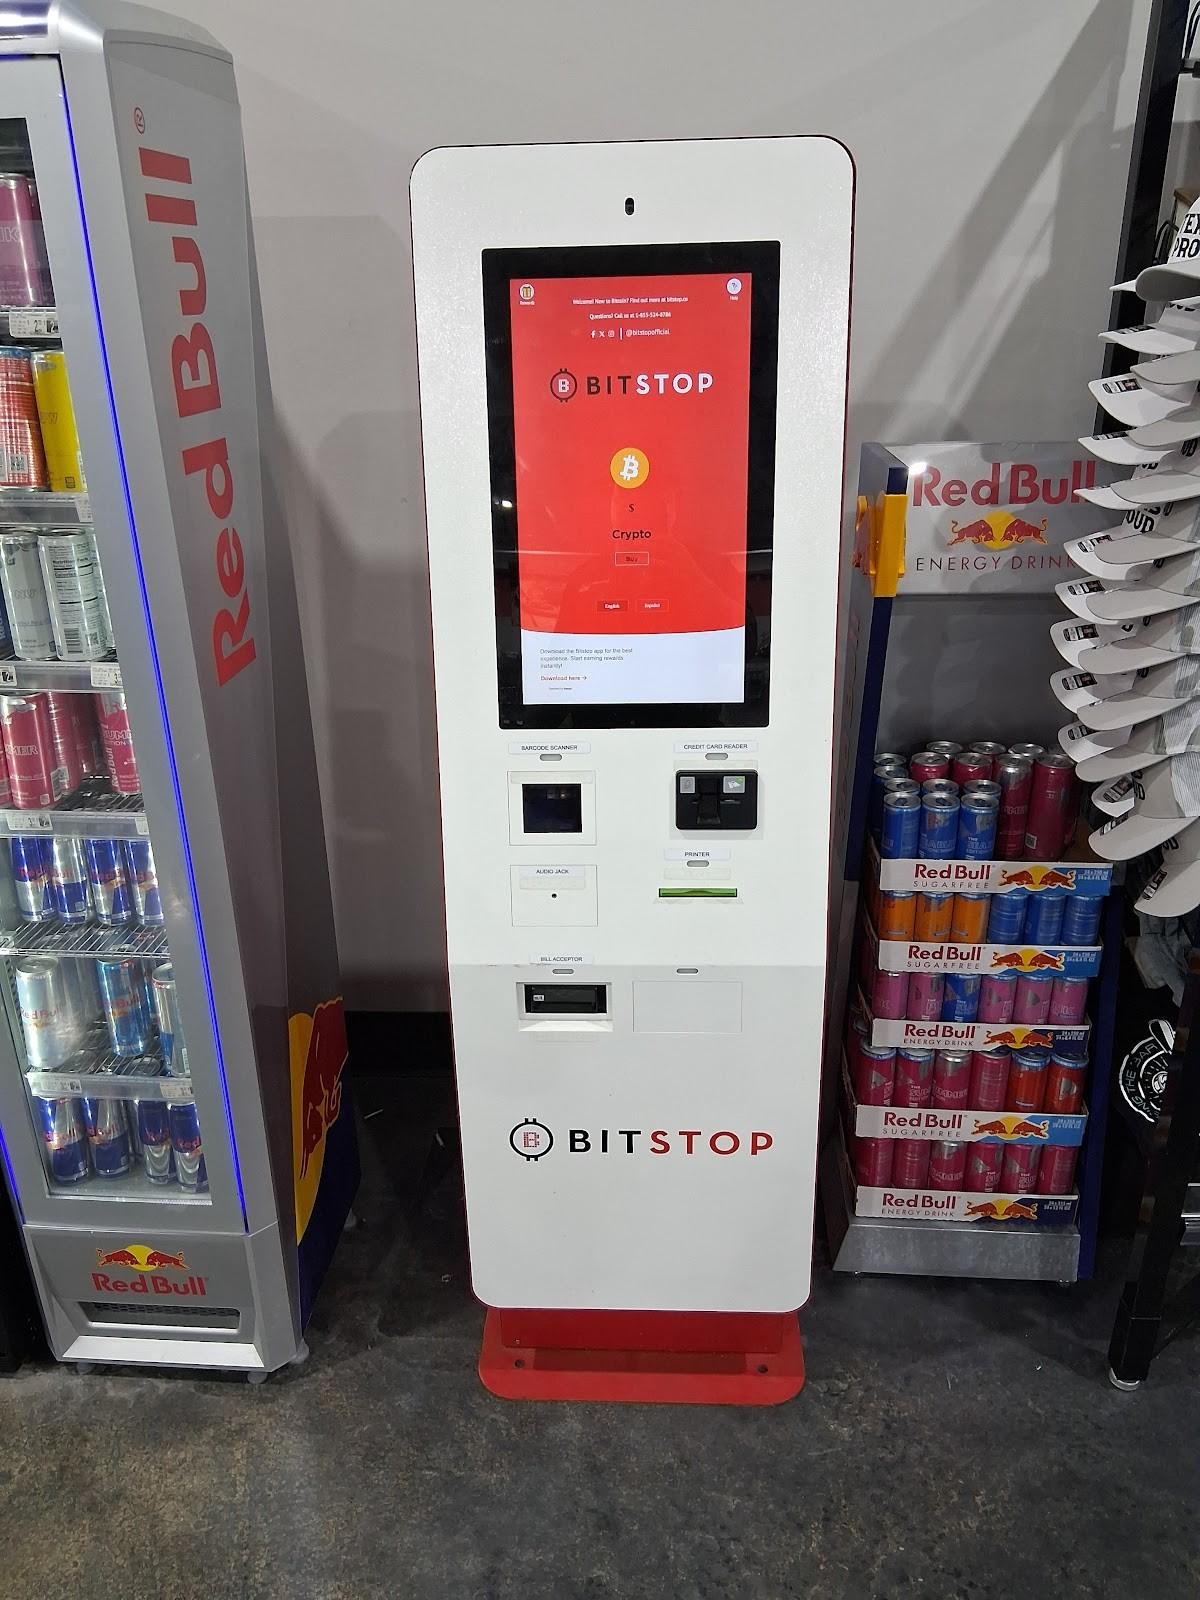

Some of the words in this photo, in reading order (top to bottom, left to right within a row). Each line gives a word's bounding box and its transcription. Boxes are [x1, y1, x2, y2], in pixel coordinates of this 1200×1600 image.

[139, 147, 222, 418] Bull
[589, 313, 614, 321] Questions?
[587, 373, 713, 395] BITSTOP
[912, 463, 1000, 507] Red
[1008, 460, 1096, 505] Bull
[612, 529, 652, 541] Crypto
[182, 438, 257, 687] Red
[916, 556, 1001, 571] ENERGY
[915, 863, 950, 879] Red
[954, 864, 990, 880] Bull
[913, 880, 990, 889] SUGARFREE
[908, 945, 944, 961] Red
[946, 946, 982, 961] Bull
[906, 960, 980, 970] SUGARFREE
[904, 1023, 938, 1038] Red
[941, 1024, 976, 1039] Bull
[903, 1037, 941, 1046] ENERGY
[944, 1039, 975, 1047] DRINK
[884, 1111, 921, 1127] Red
[925, 1113, 962, 1129] Bull
[882, 1128, 962, 1137] SUGARFREE
[569, 1129, 773, 1155] BITSTOP
[882, 1193, 918, 1208] Red
[921, 1194, 956, 1209] Bull
[881, 1208, 921, 1217] ENERGY
[924, 1209, 955, 1218] DRINK
[92, 1273, 149, 1294] Red
[151, 1275, 206, 1296] Bull
